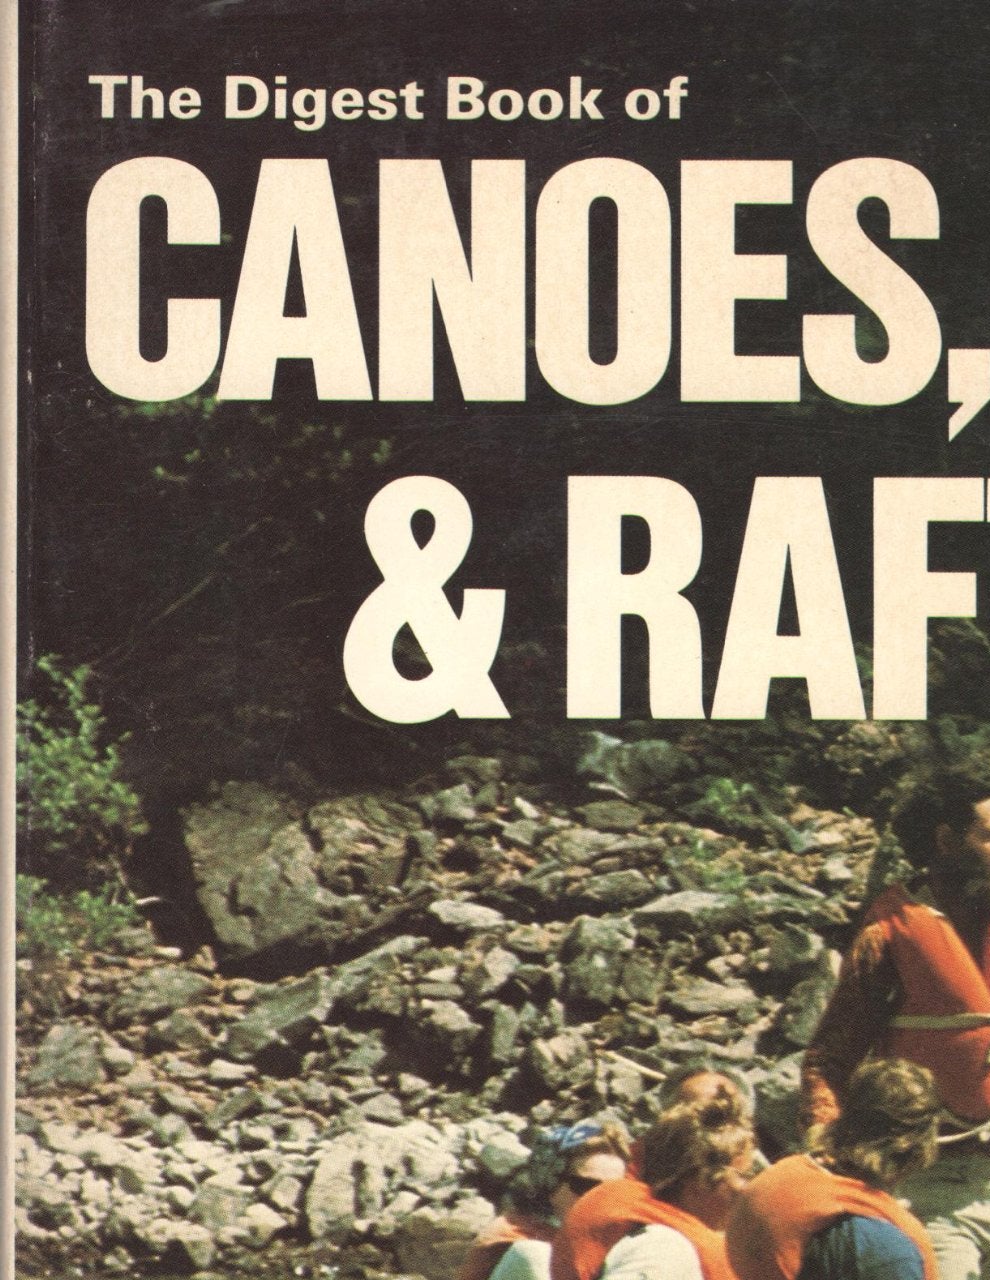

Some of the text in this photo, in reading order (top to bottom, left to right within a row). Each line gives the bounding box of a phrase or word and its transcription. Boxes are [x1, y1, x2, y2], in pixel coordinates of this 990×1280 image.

[88, 74, 689, 131] The Digest Book of
[343, 475, 511, 724] &
